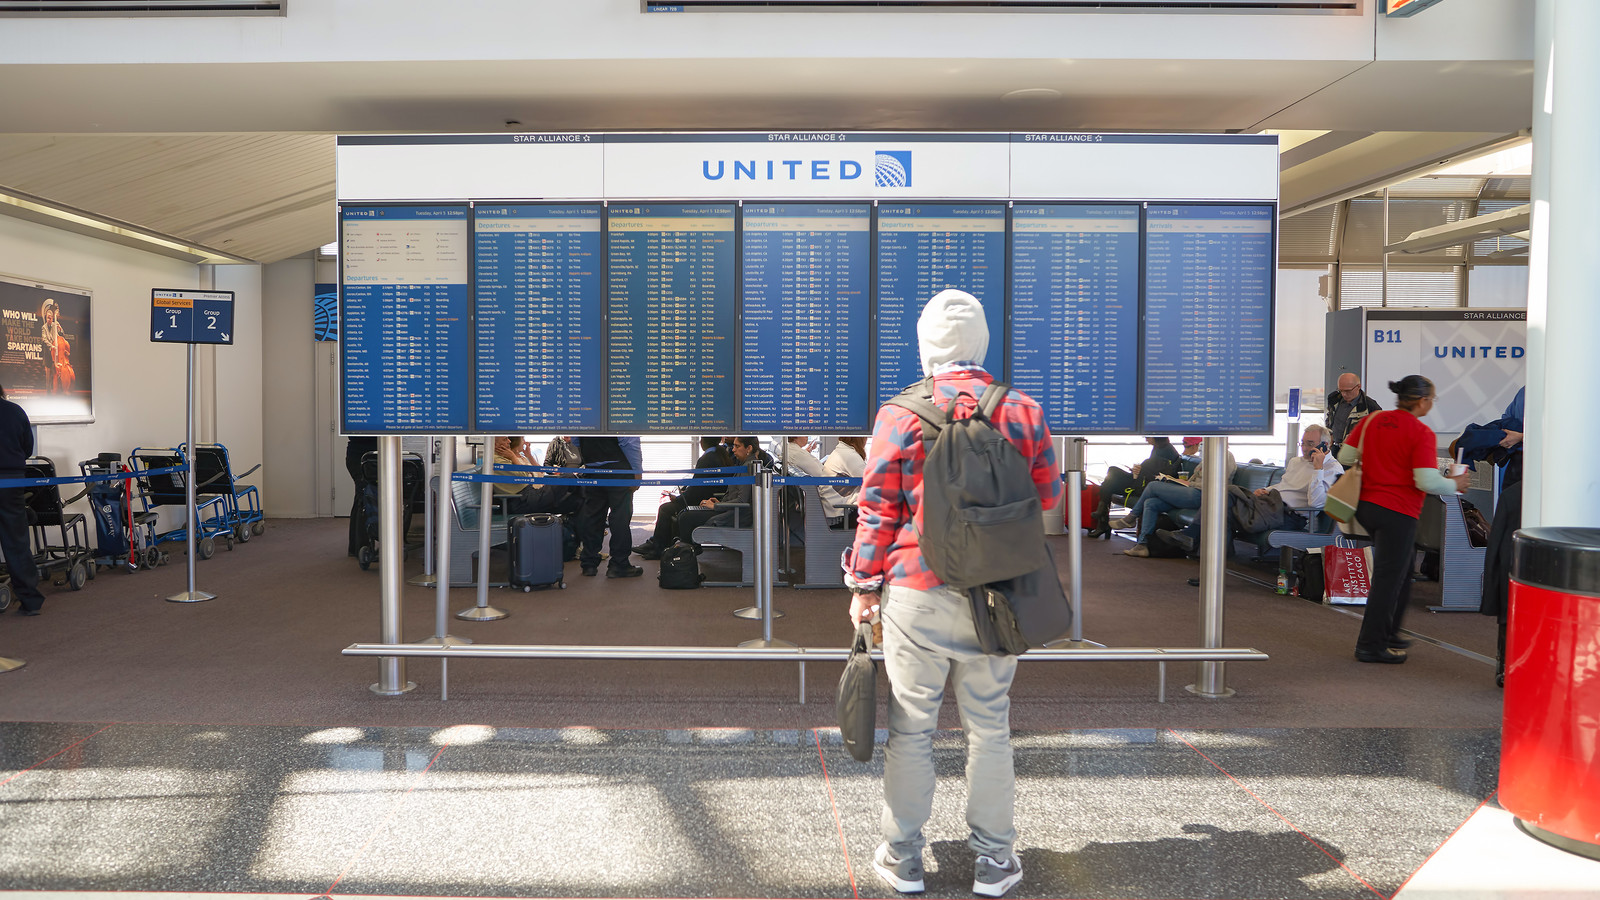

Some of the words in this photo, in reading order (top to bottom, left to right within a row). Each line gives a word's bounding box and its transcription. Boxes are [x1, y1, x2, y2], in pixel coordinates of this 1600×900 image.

[513, 134, 536, 142] STAR
[538, 134, 581, 142] ALLIANCE
[768, 133, 791, 141] STAR
[792, 133, 836, 141] ALLIANCE
[1025, 134, 1048, 142] STAR
[1049, 134, 1093, 142] ALLIANCE
[702, 160, 862, 180] UNITED
[2, 309, 20, 319] WHO
[21, 311, 38, 321] WILL
[1, 318, 20, 327] MAKE
[169, 315, 177, 328] 1
[207, 316, 217, 330] 2
[6, 326, 31, 336] WORLD
[1374, 329, 1402, 343] B11
[5, 334, 23, 343] TAKE
[7, 341, 43, 352] SPARTANS
[1434, 346, 1524, 359] UNITED
[25, 351, 43, 360] WILL.
[1345, 551, 1359, 594] INSTITVTE
[1354, 556, 1369, 594] CHICAGO
[1342, 578, 1351, 594] ART
